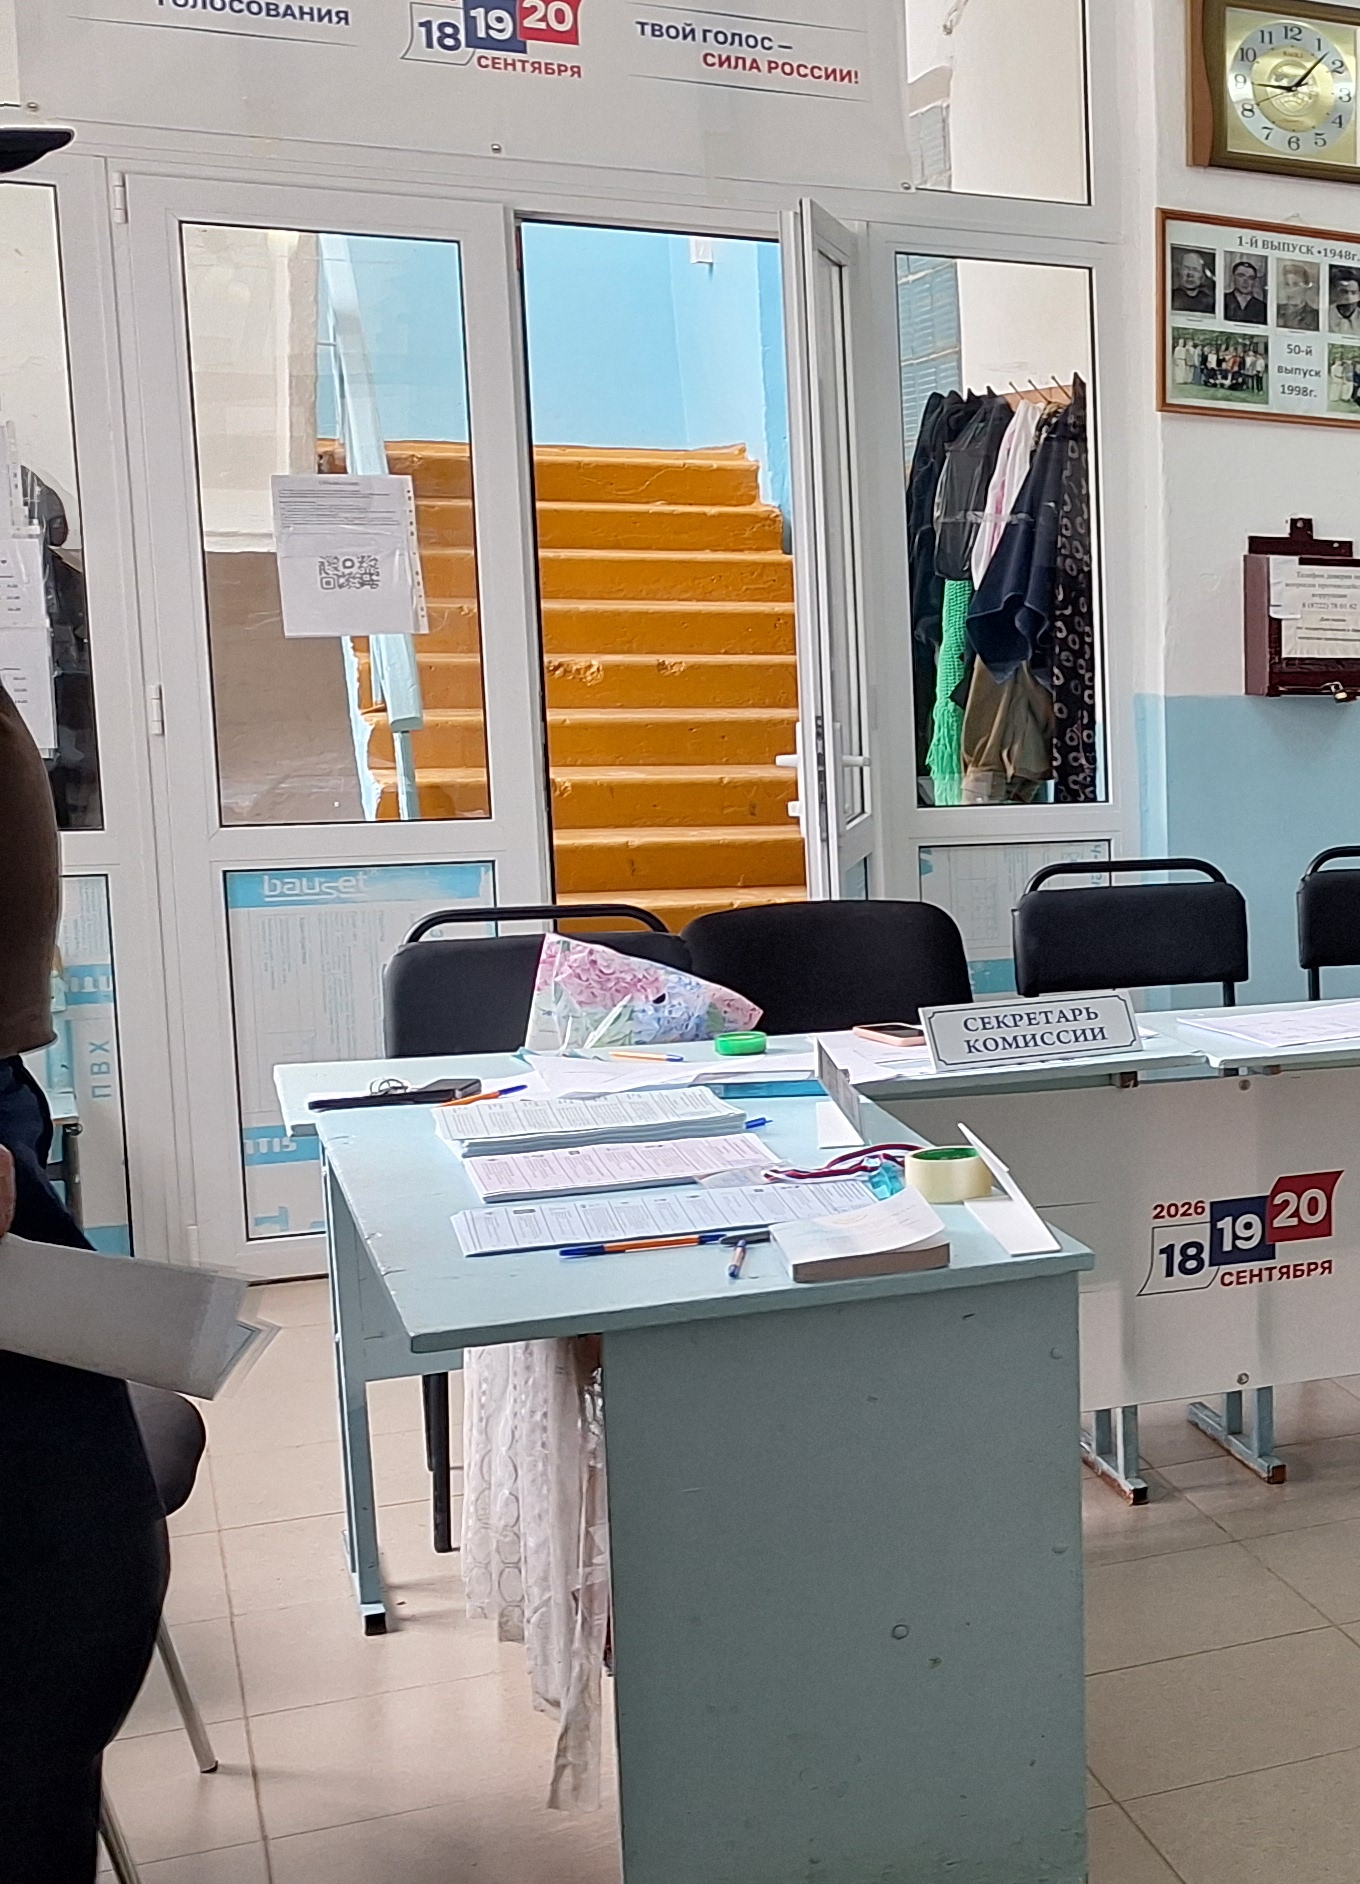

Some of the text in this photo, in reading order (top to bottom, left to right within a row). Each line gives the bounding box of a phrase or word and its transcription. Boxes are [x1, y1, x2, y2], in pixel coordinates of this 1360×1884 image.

[418, 0, 574, 51] 18 19 20
[1282, 25, 1303, 42] 12
[636, 20, 697, 42] ТВОЙ
[701, 27, 773, 51] ГОЛОС
[1259, 30, 1273, 45] 11
[1315, 38, 1322, 52] 1
[1238, 47, 1257, 63] 10
[476, 55, 582, 78] СЕНТЯБРЯ
[702, 52, 859, 84] СИЛА РОССИИ!
[1331, 59, 1346, 75] 2
[1234, 73, 1247, 89] 9
[1339, 87, 1352, 103] 3
[1241, 103, 1256, 118] 8
[1331, 114, 1343, 129] 4
[1261, 126, 1275, 141] 7
[1314, 132, 1327, 148] 5
[1287, 135, 1300, 151] 6
[1262, 239, 1314, 256] ВЫПУСК
[1286, 343, 1313, 357] 50-й
[1277, 364, 1321, 380] выпуск
[262, 874, 369, 899] bauset
[962, 1006, 1099, 1033] СЕКРЕТАРЬ
[964, 1026, 1109, 1055] КОМИССИИ
[1152, 1200, 1206, 1220] 2026
[1158, 1188, 1328, 1278] 18 19 20
[1219, 1259, 1333, 1287] СЕНТЯБРЯ
